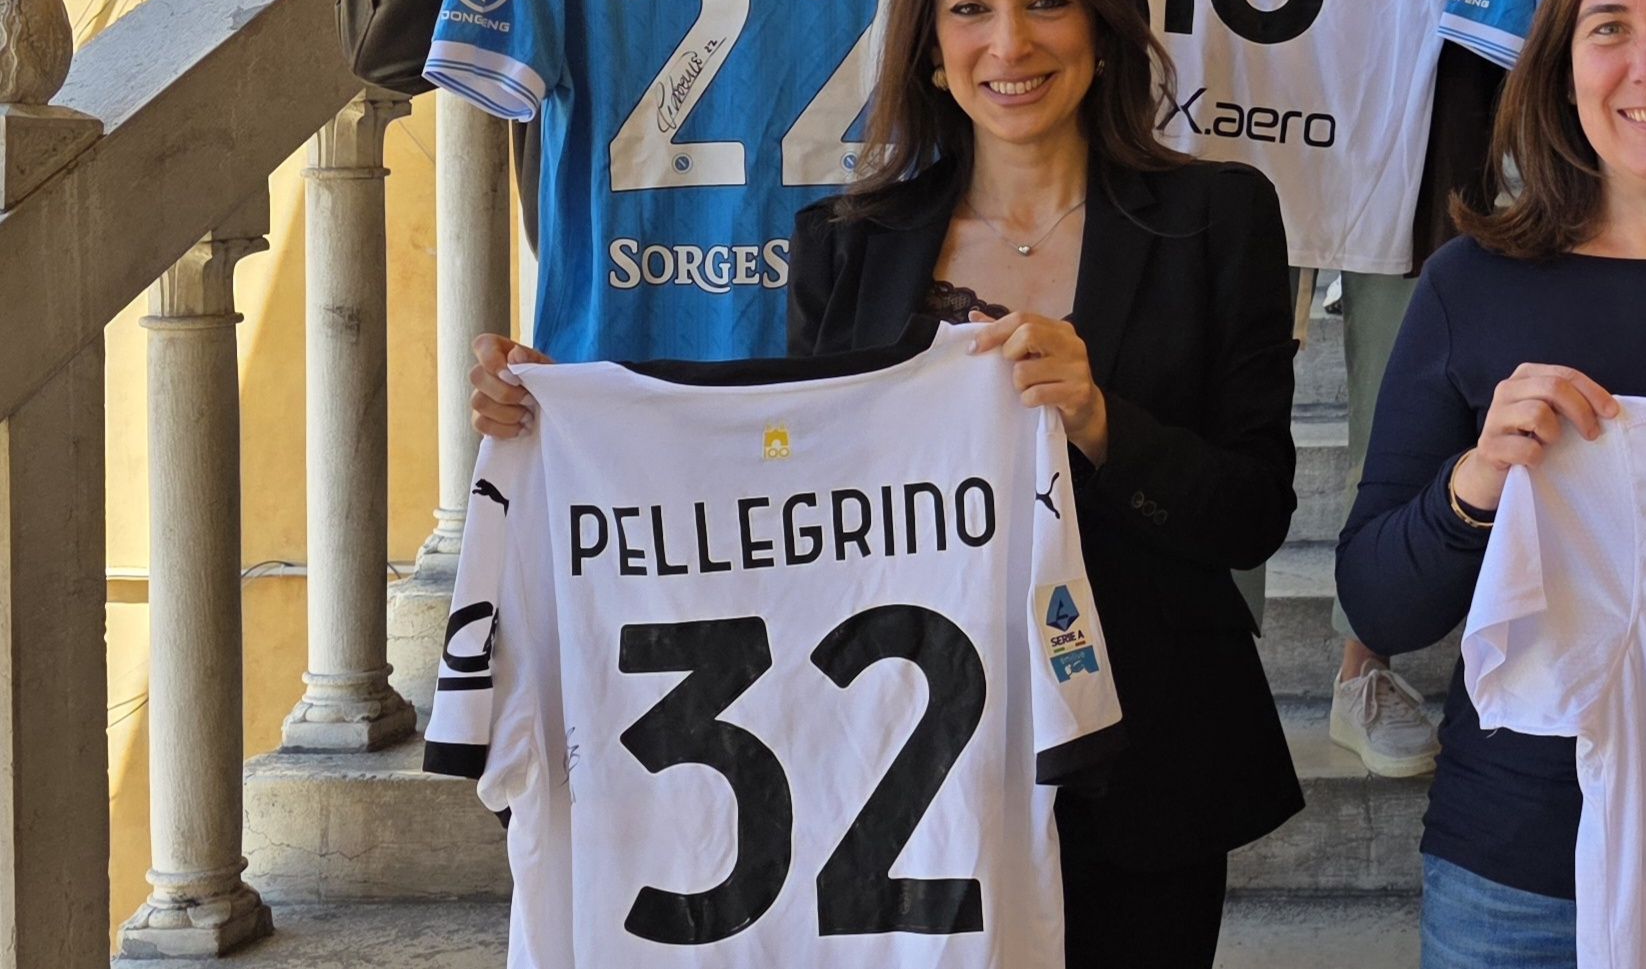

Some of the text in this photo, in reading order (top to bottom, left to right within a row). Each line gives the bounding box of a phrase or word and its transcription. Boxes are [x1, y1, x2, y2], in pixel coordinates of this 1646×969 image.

[570, 477, 997, 577] PELLEGRINO
[1050, 629, 1085, 647] SERIE A
[617, 602, 987, 946] 32
